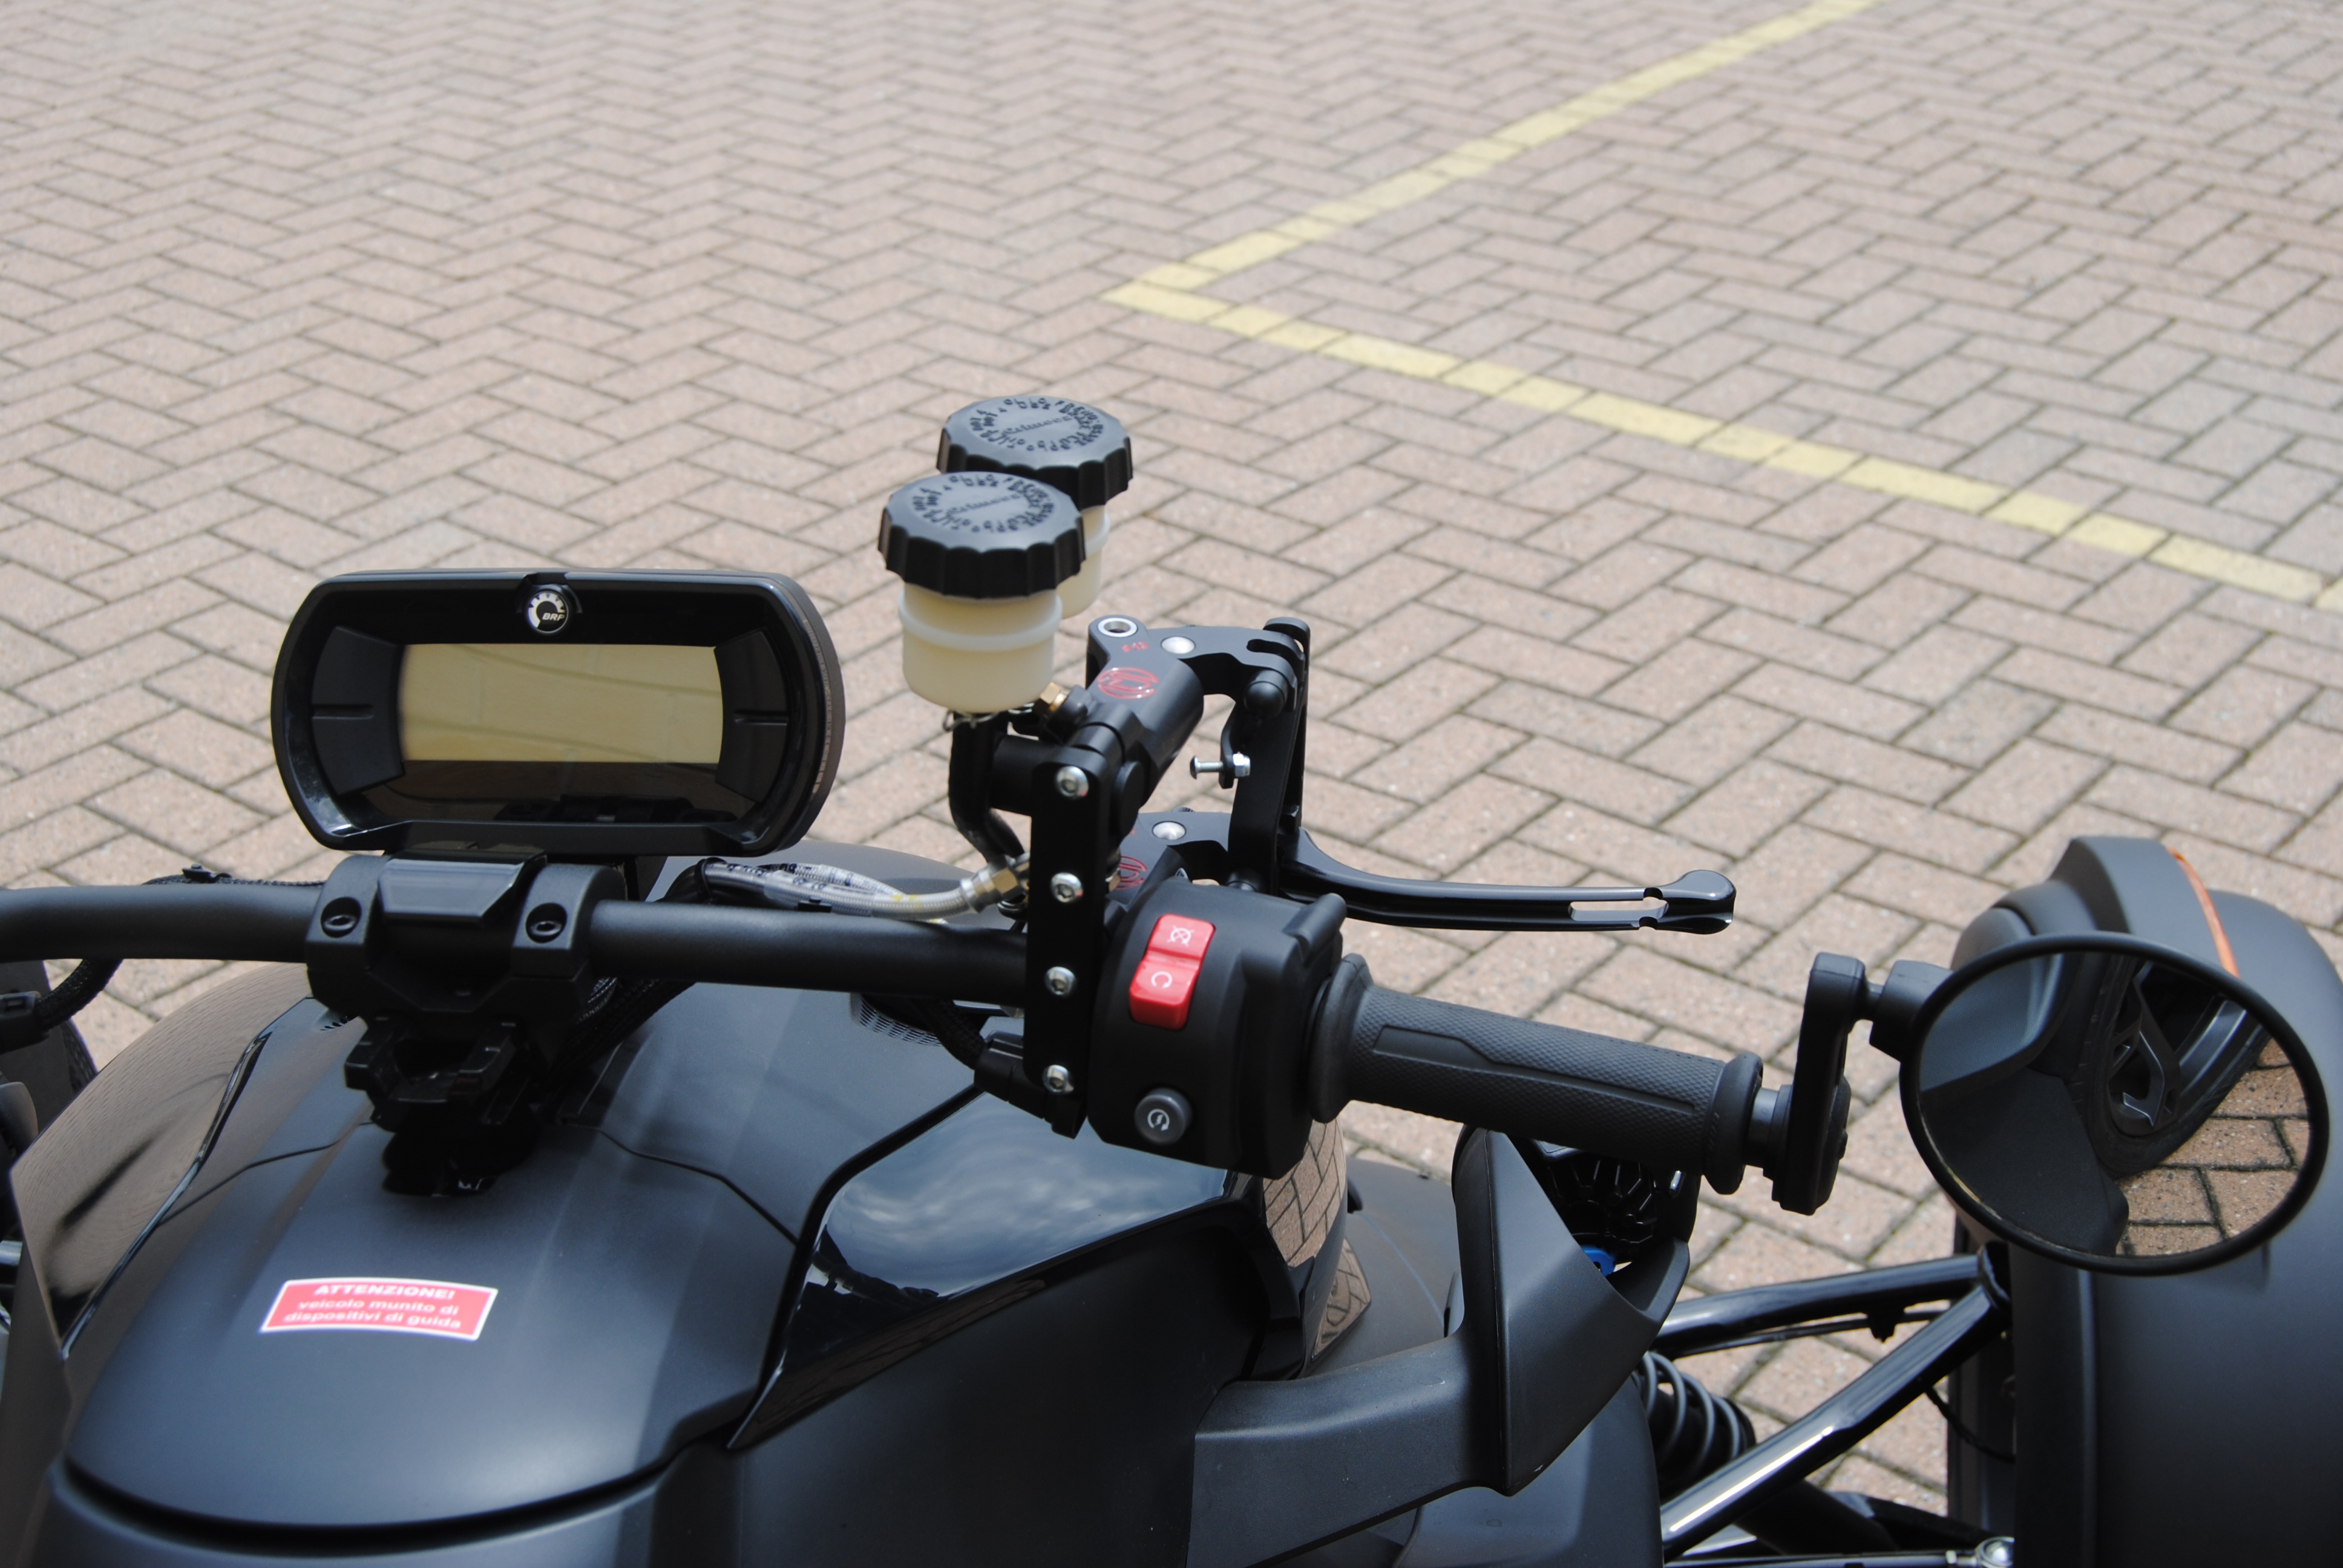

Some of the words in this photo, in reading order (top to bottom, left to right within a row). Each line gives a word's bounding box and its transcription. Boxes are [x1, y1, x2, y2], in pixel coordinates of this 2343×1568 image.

[298, 1299, 364, 1310] veicolo
[369, 1300, 436, 1313] munito
[439, 1305, 459, 1316] di
[284, 1311, 381, 1323] dispositivi
[384, 1312, 404, 1323] di
[407, 1315, 462, 1329] guida
